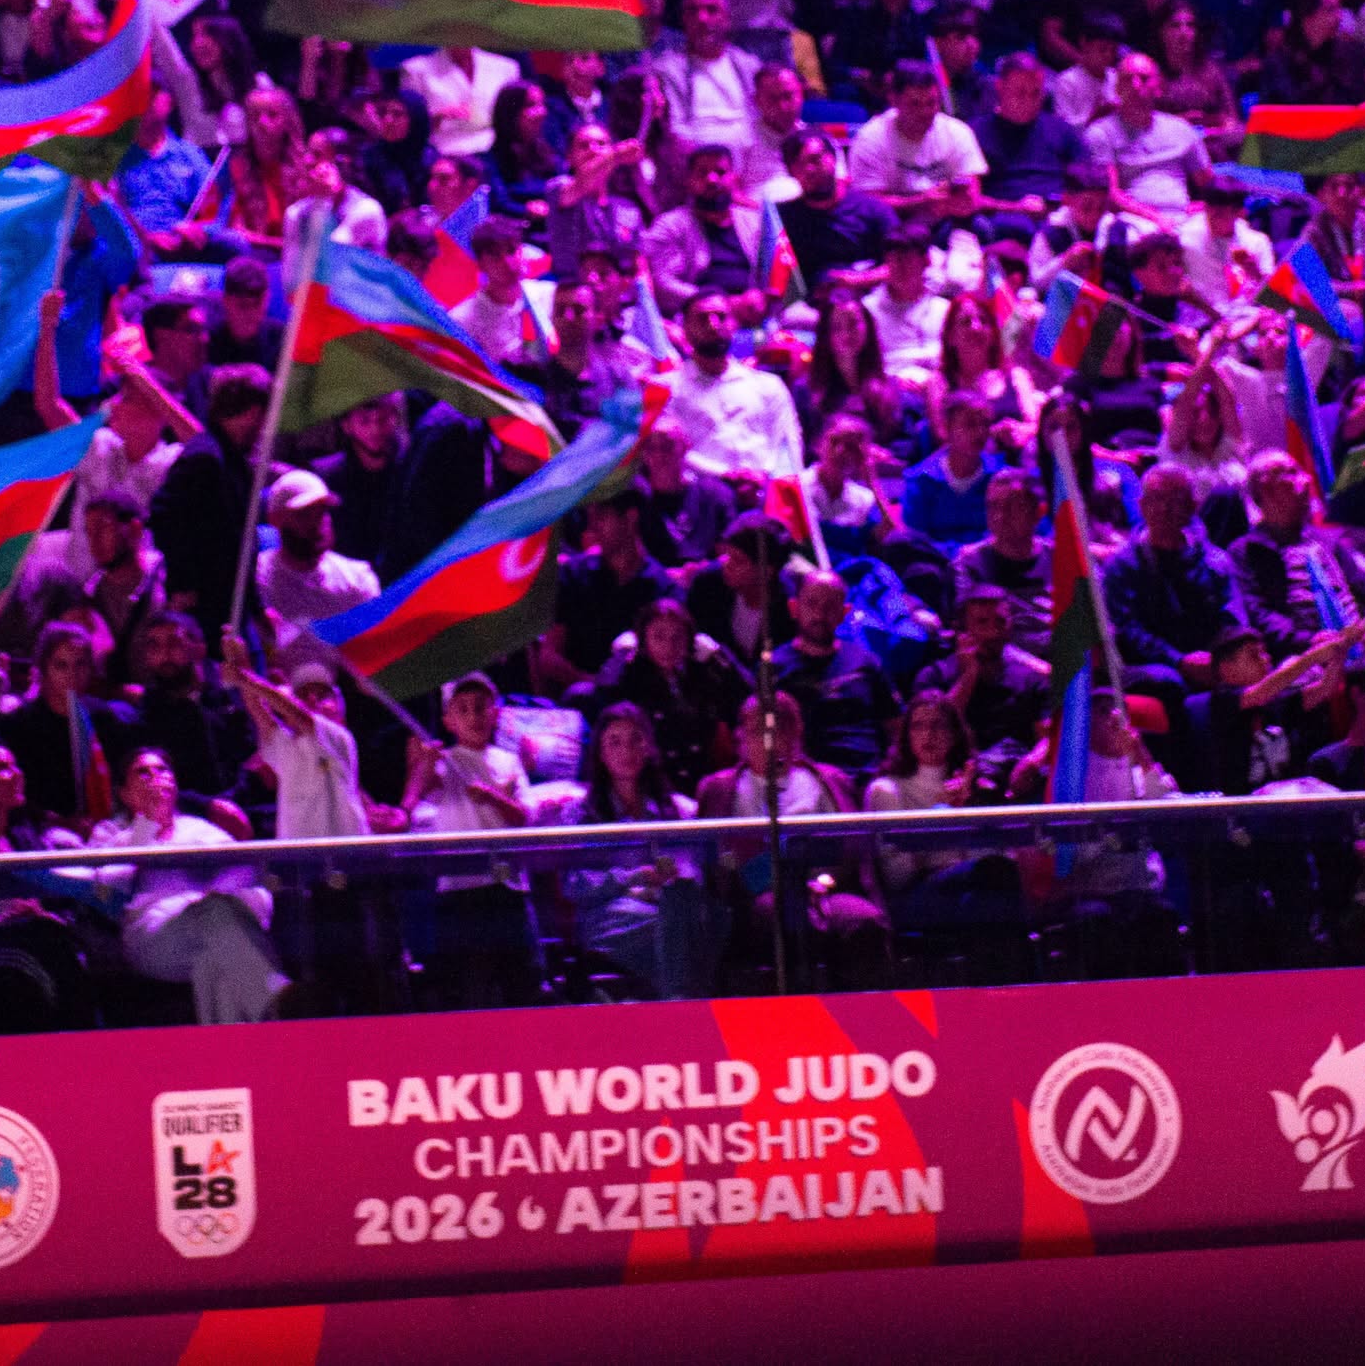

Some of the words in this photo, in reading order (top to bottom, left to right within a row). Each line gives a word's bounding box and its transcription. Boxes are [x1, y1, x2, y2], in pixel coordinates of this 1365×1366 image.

[347, 1071, 523, 1128] BAKU
[535, 1059, 759, 1117] WORLD
[773, 1050, 937, 1104] JUDO
[414, 1114, 881, 1181] CHAMPIONSHIPS
[174, 1176, 237, 1210] 28
[354, 1191, 504, 1246] 2026
[556, 1166, 945, 1234] AZERBAIJAN
